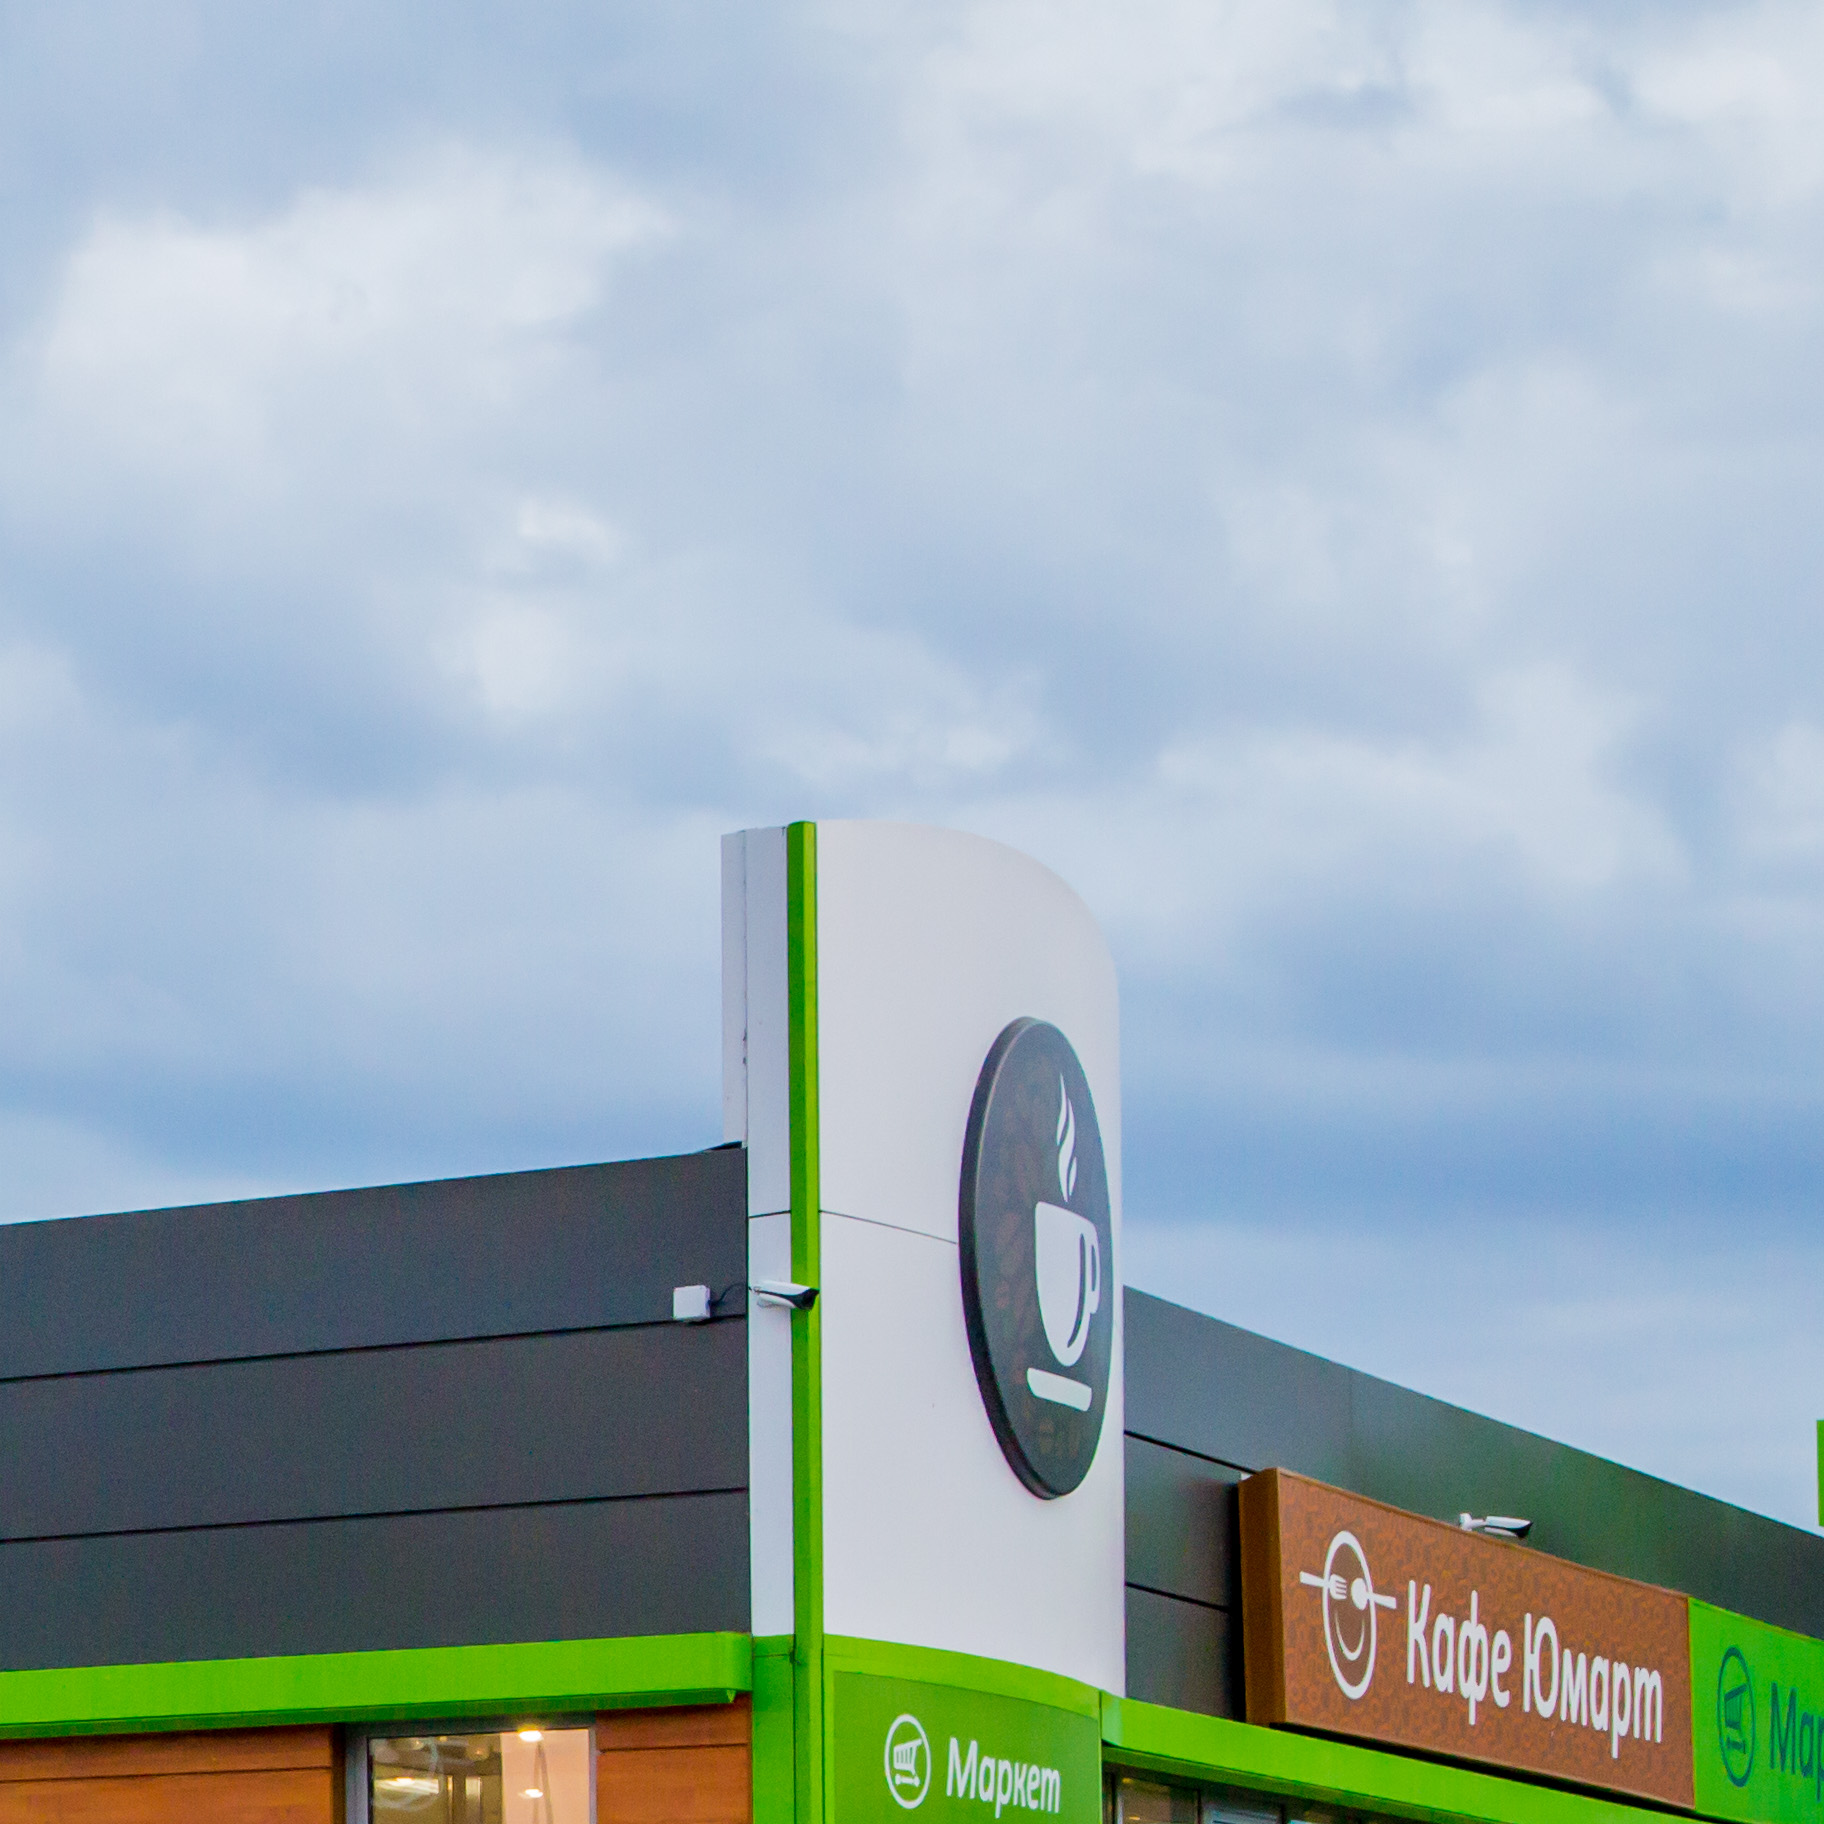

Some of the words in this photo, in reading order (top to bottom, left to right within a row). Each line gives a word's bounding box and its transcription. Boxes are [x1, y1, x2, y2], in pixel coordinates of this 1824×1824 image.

[1407, 1579, 1511, 1726] Кафе
[1523, 1612, 1663, 1759] Юмарт
[945, 1736, 1062, 1819] Маркет
